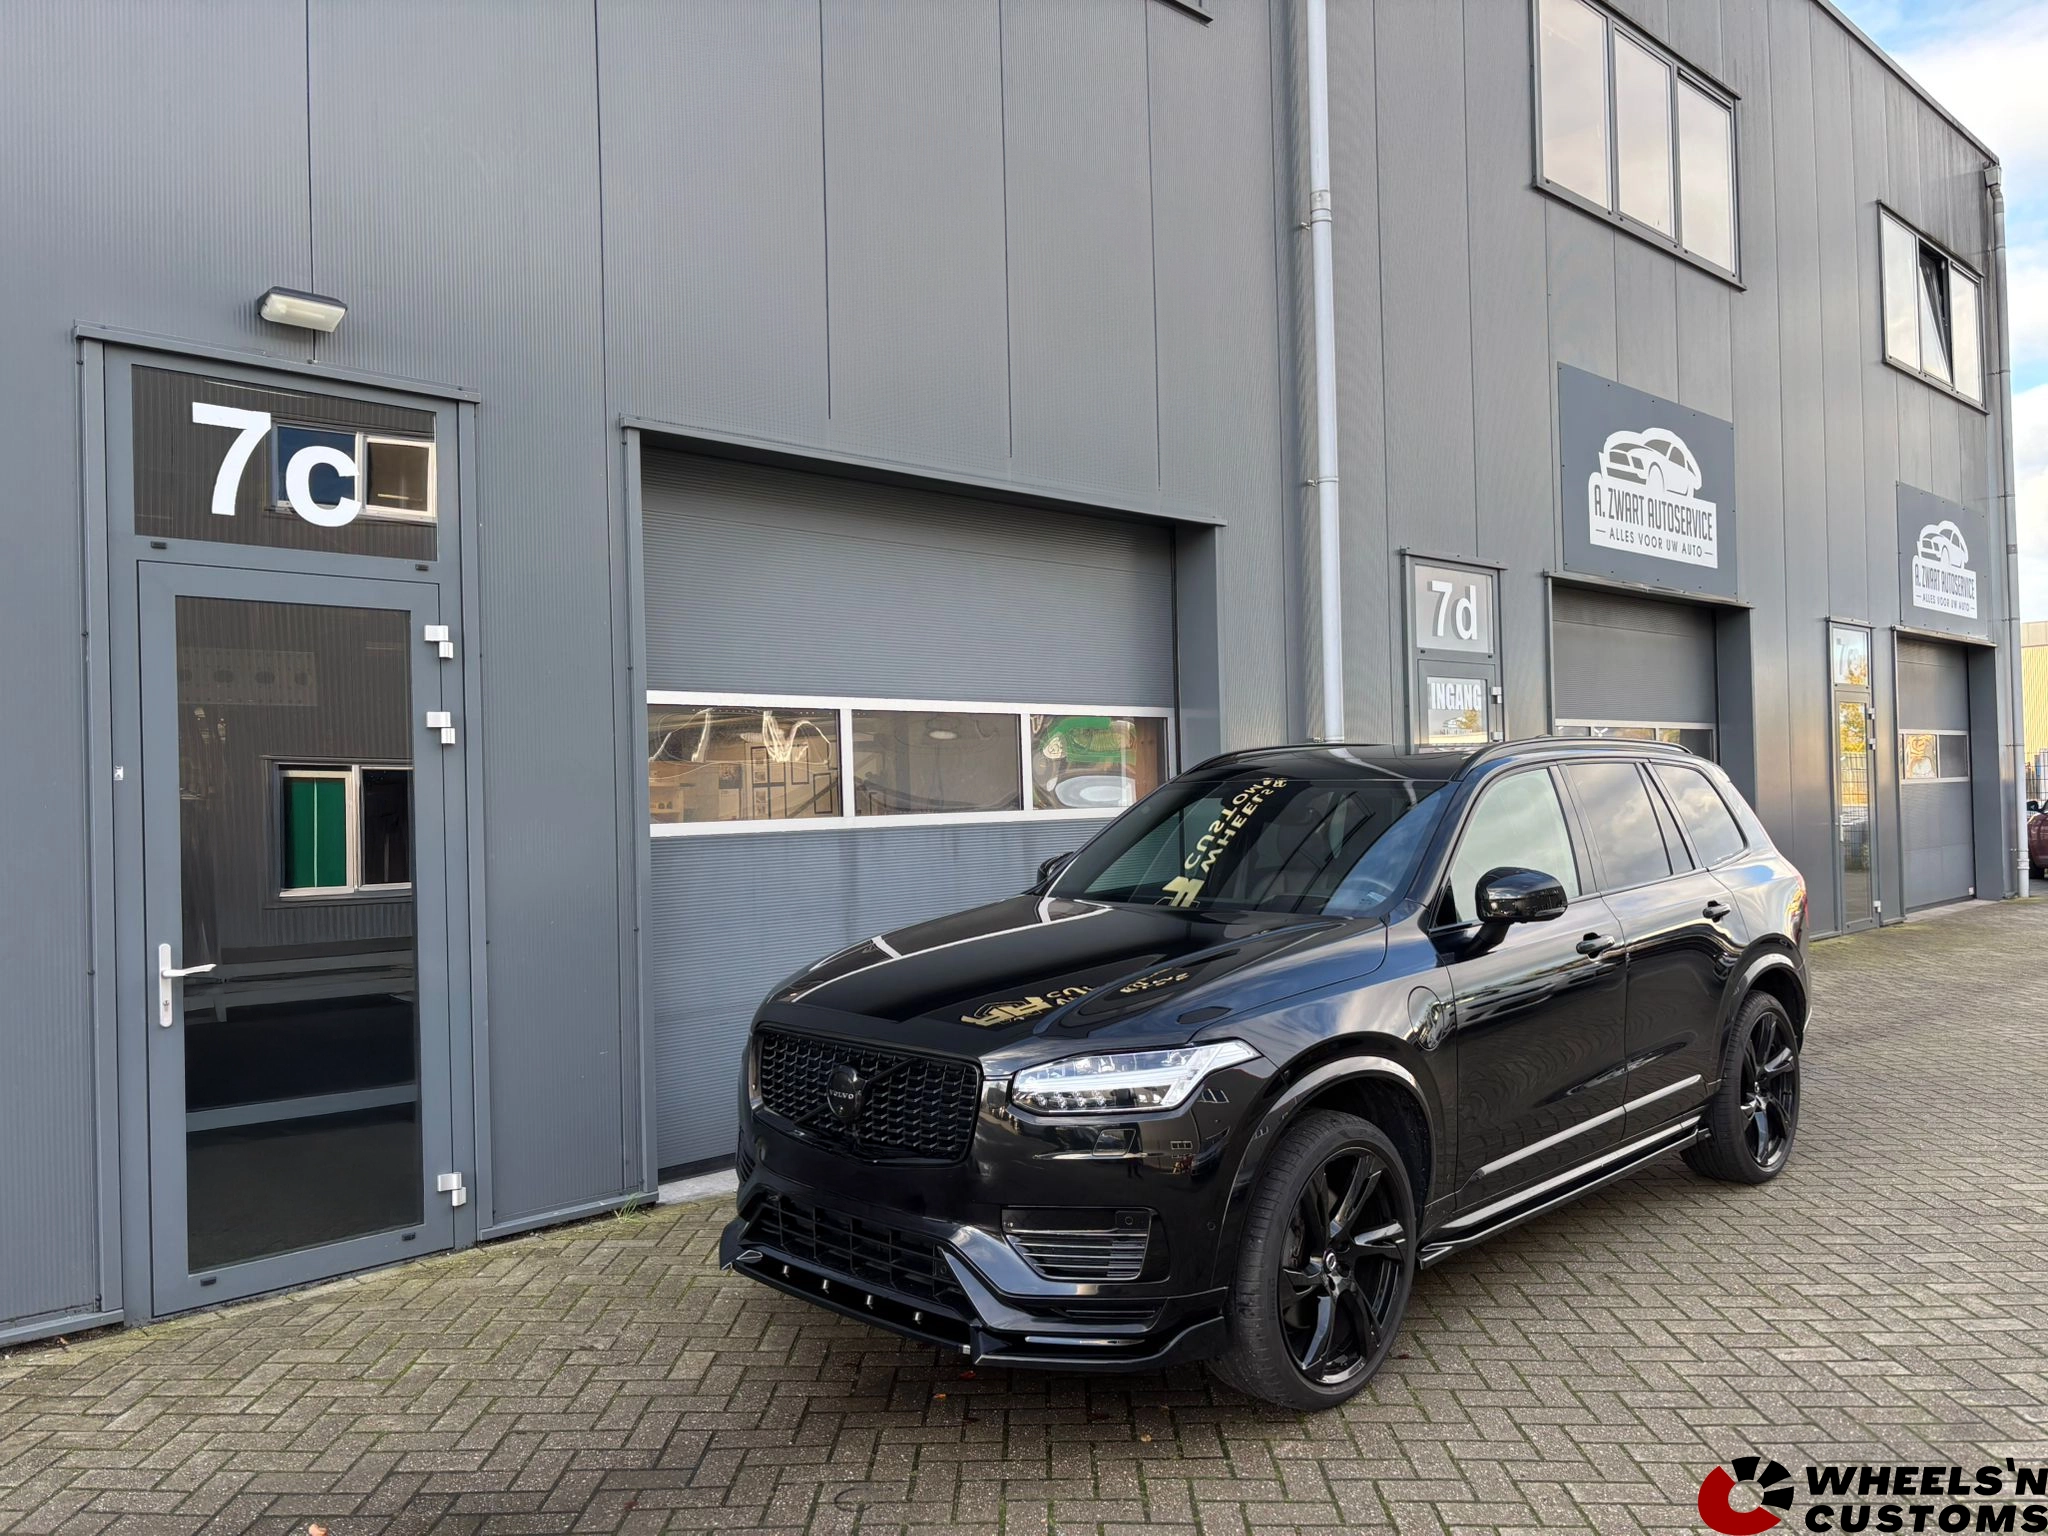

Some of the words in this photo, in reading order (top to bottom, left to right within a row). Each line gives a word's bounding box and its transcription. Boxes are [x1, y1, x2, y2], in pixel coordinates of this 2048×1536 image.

[192, 402, 360, 527] 7c
[1594, 484, 1606, 518] A.
[1608, 487, 1645, 526] ZWART
[1647, 498, 1713, 541] AUTOSERVICE
[1609, 527, 1635, 543] ALLES
[1638, 533, 1663, 550] VOOR
[1666, 540, 1679, 552] UW
[1681, 543, 1703, 557] AUTO
[1922, 565, 1940, 592] ZWART
[1941, 571, 1975, 600] AUTOSERVICE
[1429, 580, 1477, 640] 7d
[1431, 682, 1482, 711] INGANG
